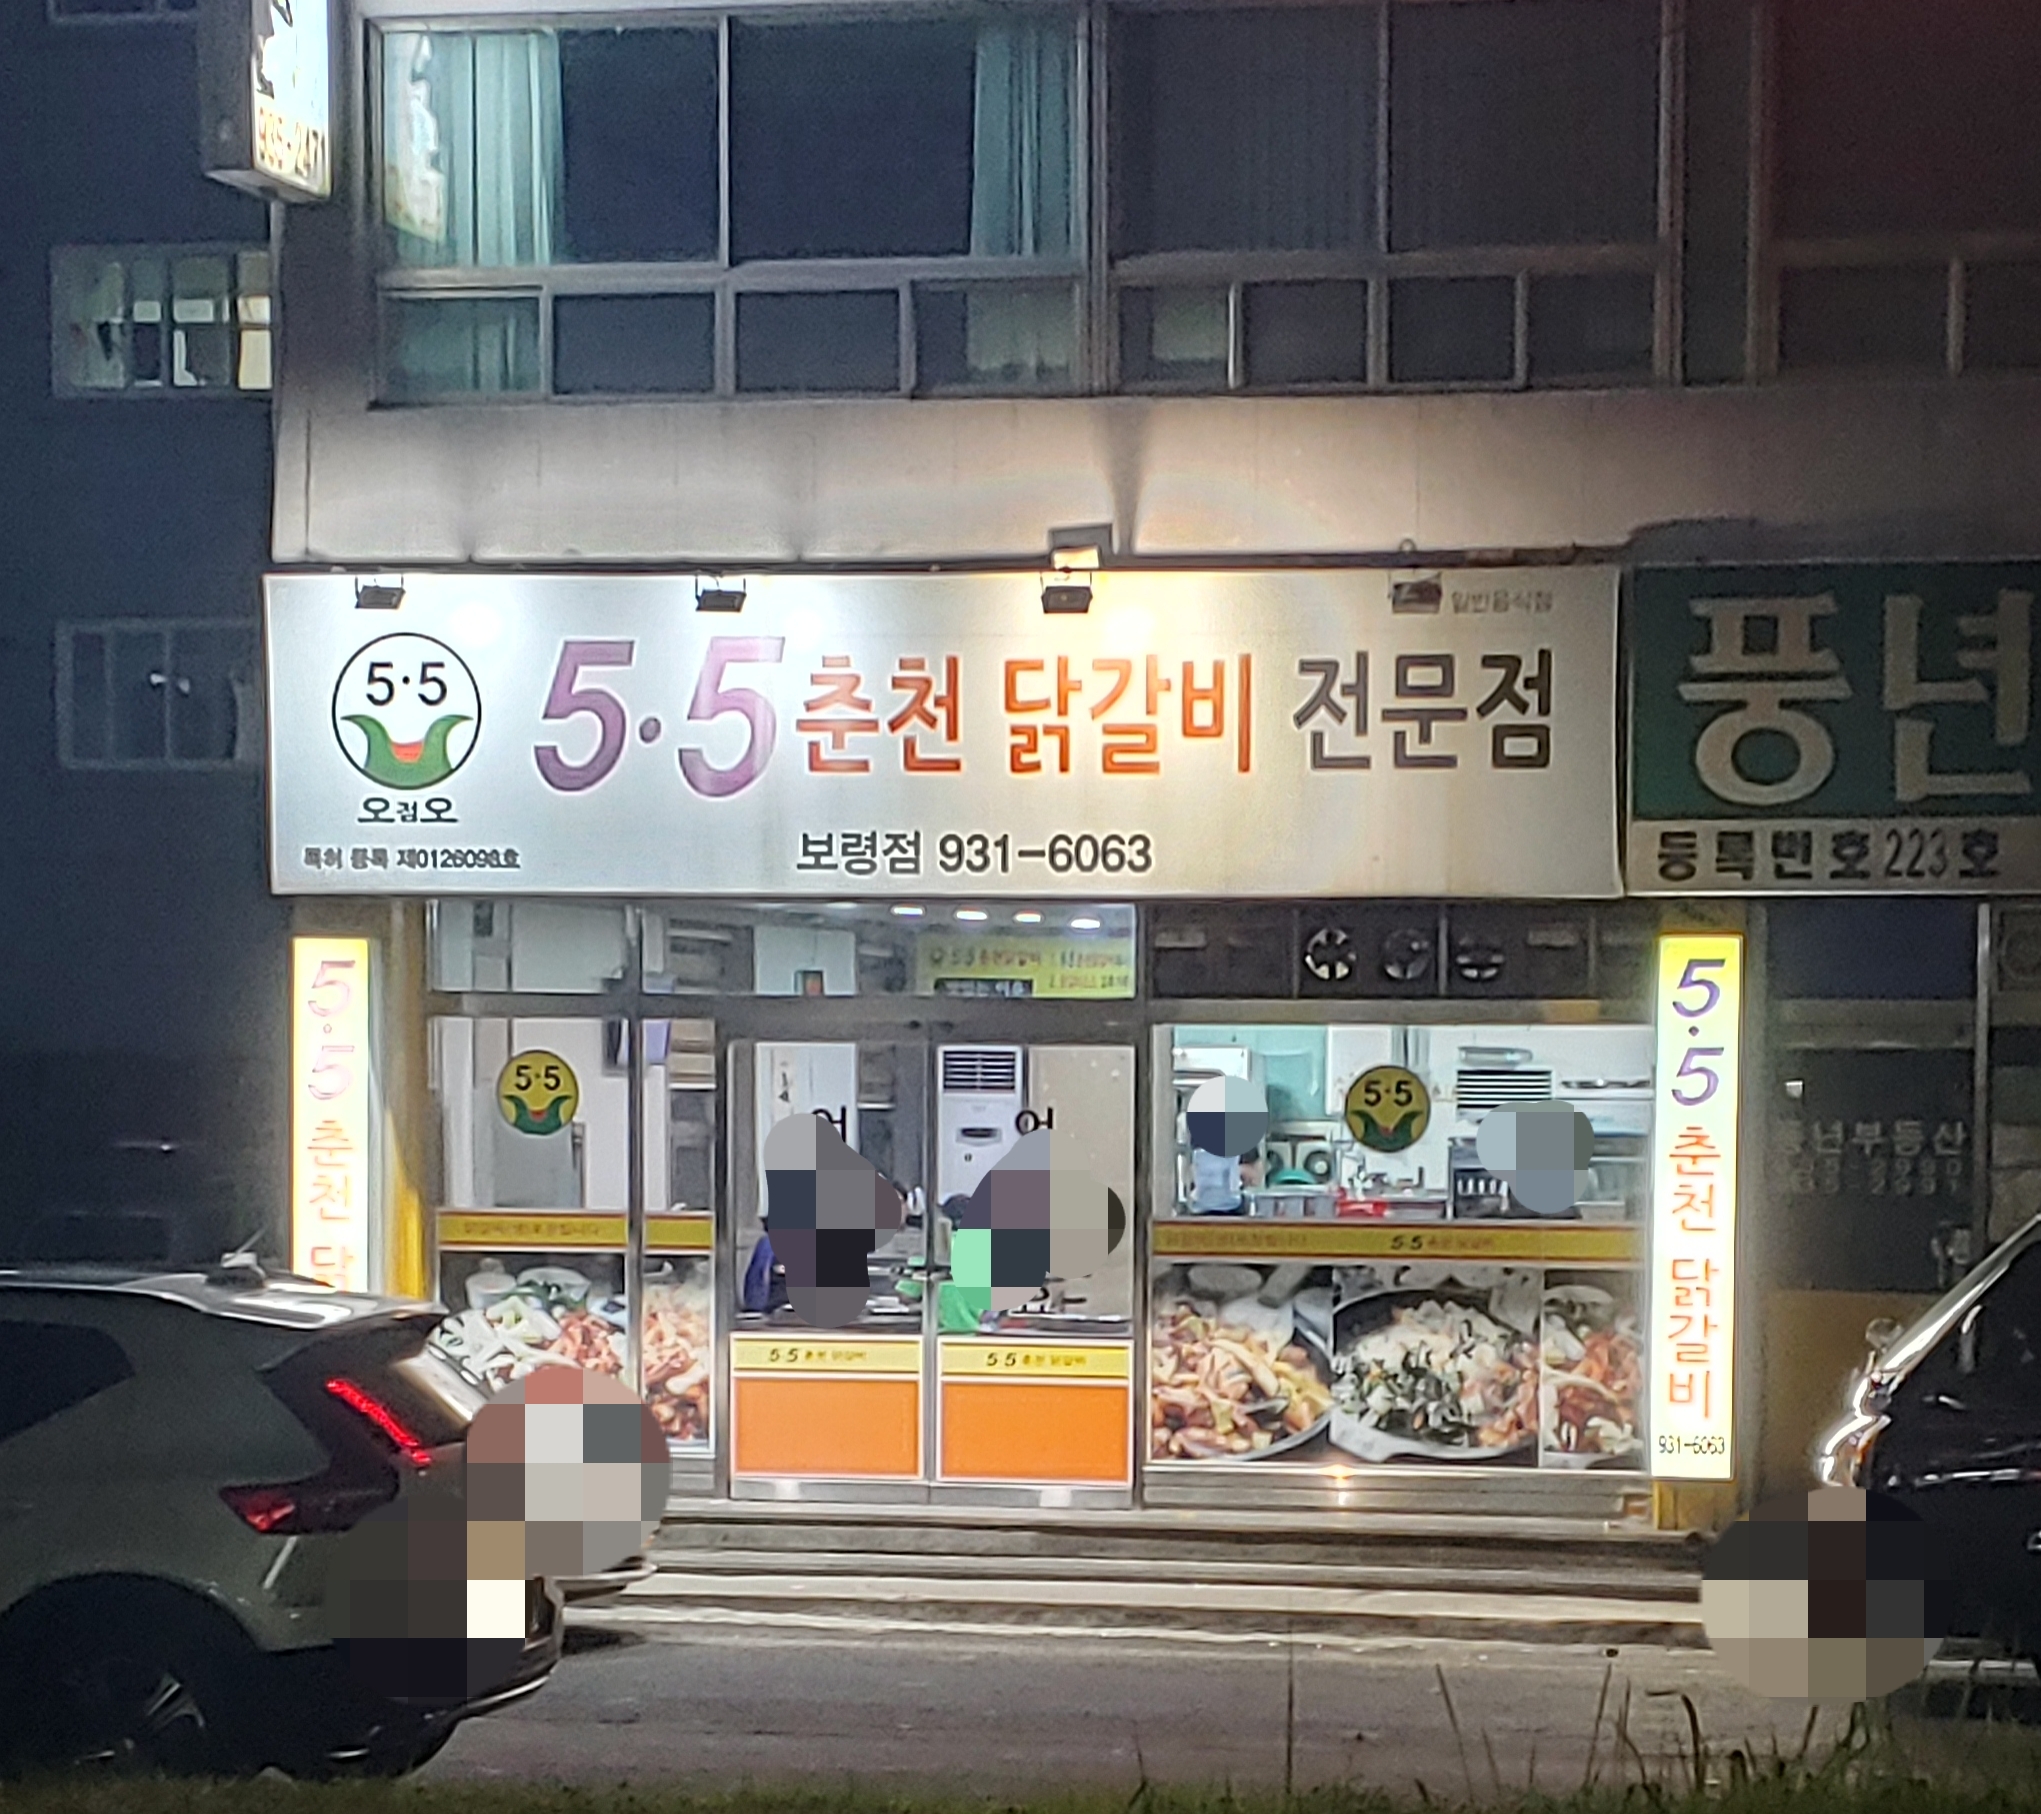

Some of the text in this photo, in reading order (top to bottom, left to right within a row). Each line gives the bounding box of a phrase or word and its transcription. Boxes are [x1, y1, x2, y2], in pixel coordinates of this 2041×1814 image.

[366, 661, 447, 706] 5·5
[532, 636, 1552, 798] 5·5 춘천 닭갈비 전문점
[1678, 588, 2034, 806] 풍년
[796, 831, 1153, 875] 보령점 931-6063
[1658, 828, 2001, 881] 등록번호 223호
[306, 1119, 354, 1221] 춘천
[1668, 1126, 1722, 1231] 춘천
[1668, 1258, 1720, 1419] 닭갈비
